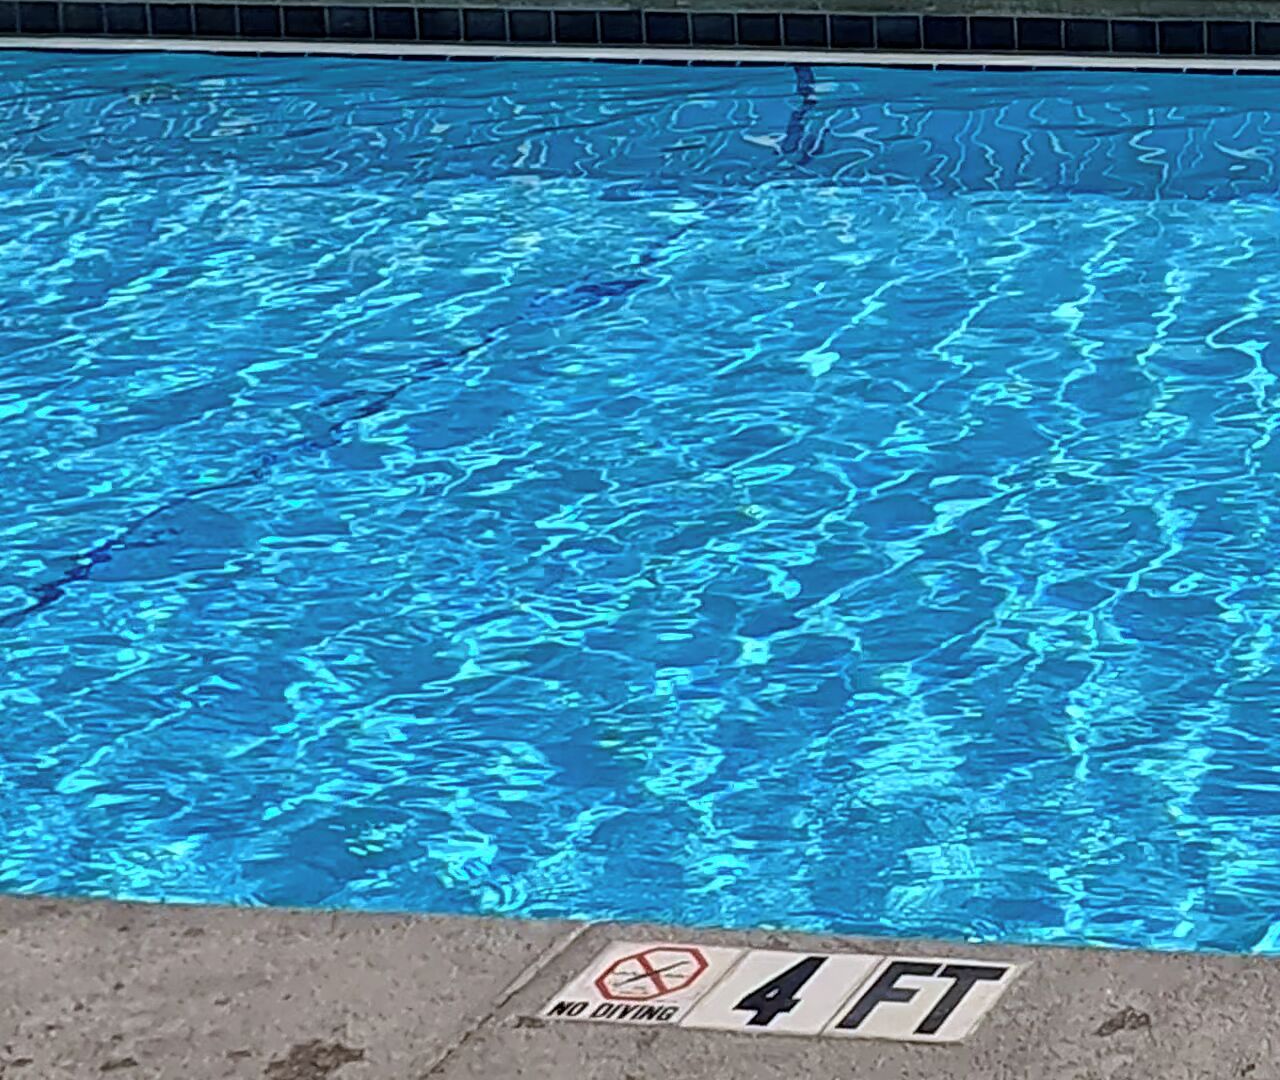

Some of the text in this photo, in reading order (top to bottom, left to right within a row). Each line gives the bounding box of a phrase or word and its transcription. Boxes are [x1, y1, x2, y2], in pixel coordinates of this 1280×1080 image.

[547, 1001, 680, 1021] NO DIVING
[732, 956, 1008, 1035] 4 FT
